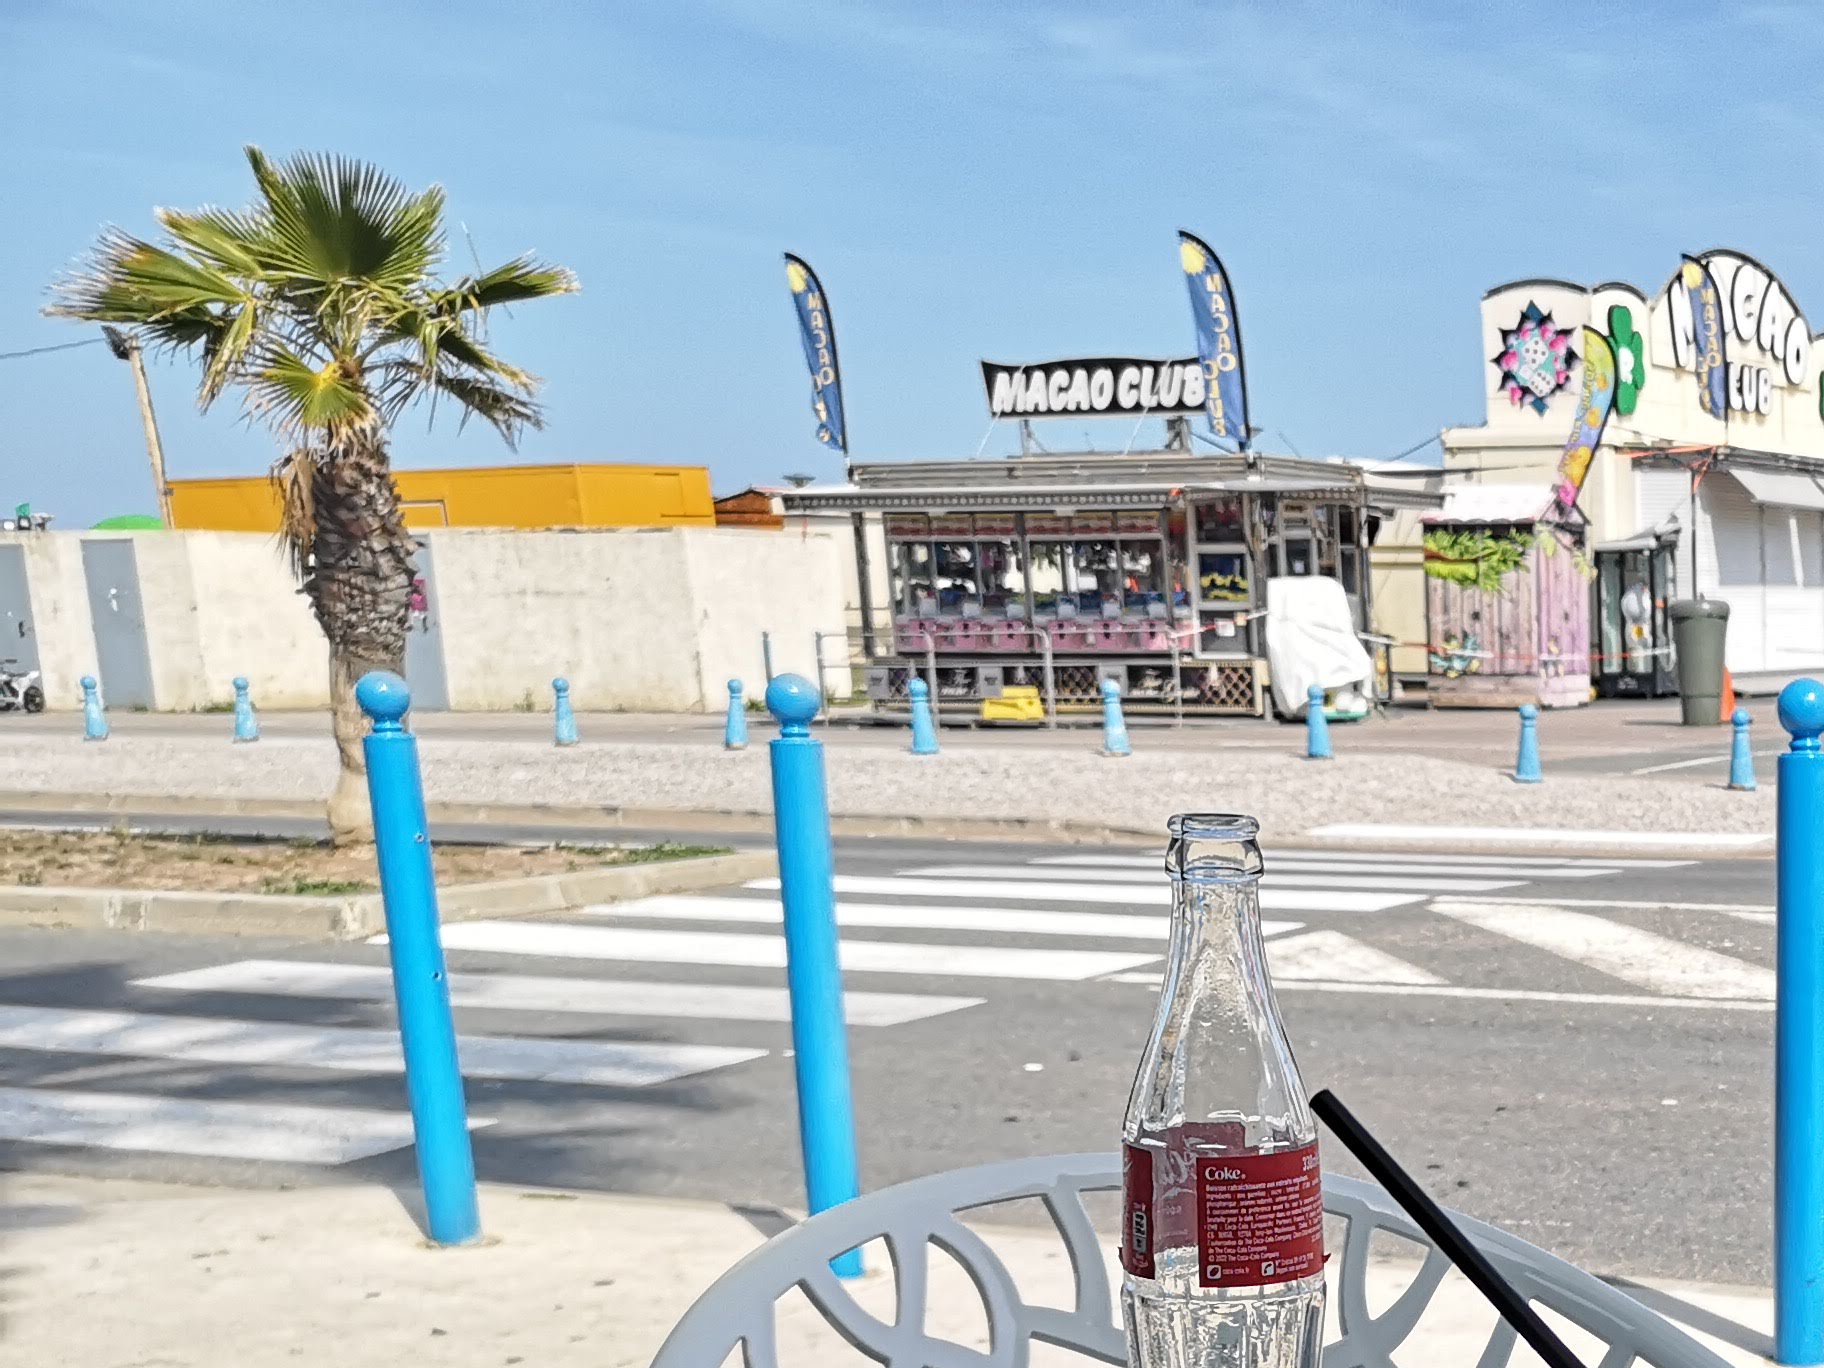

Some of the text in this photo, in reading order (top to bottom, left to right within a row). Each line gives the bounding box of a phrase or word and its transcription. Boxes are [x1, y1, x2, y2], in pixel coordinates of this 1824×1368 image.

[993, 362, 1206, 413] MACAO CLUB
[1205, 1166, 1241, 1180] Coke
